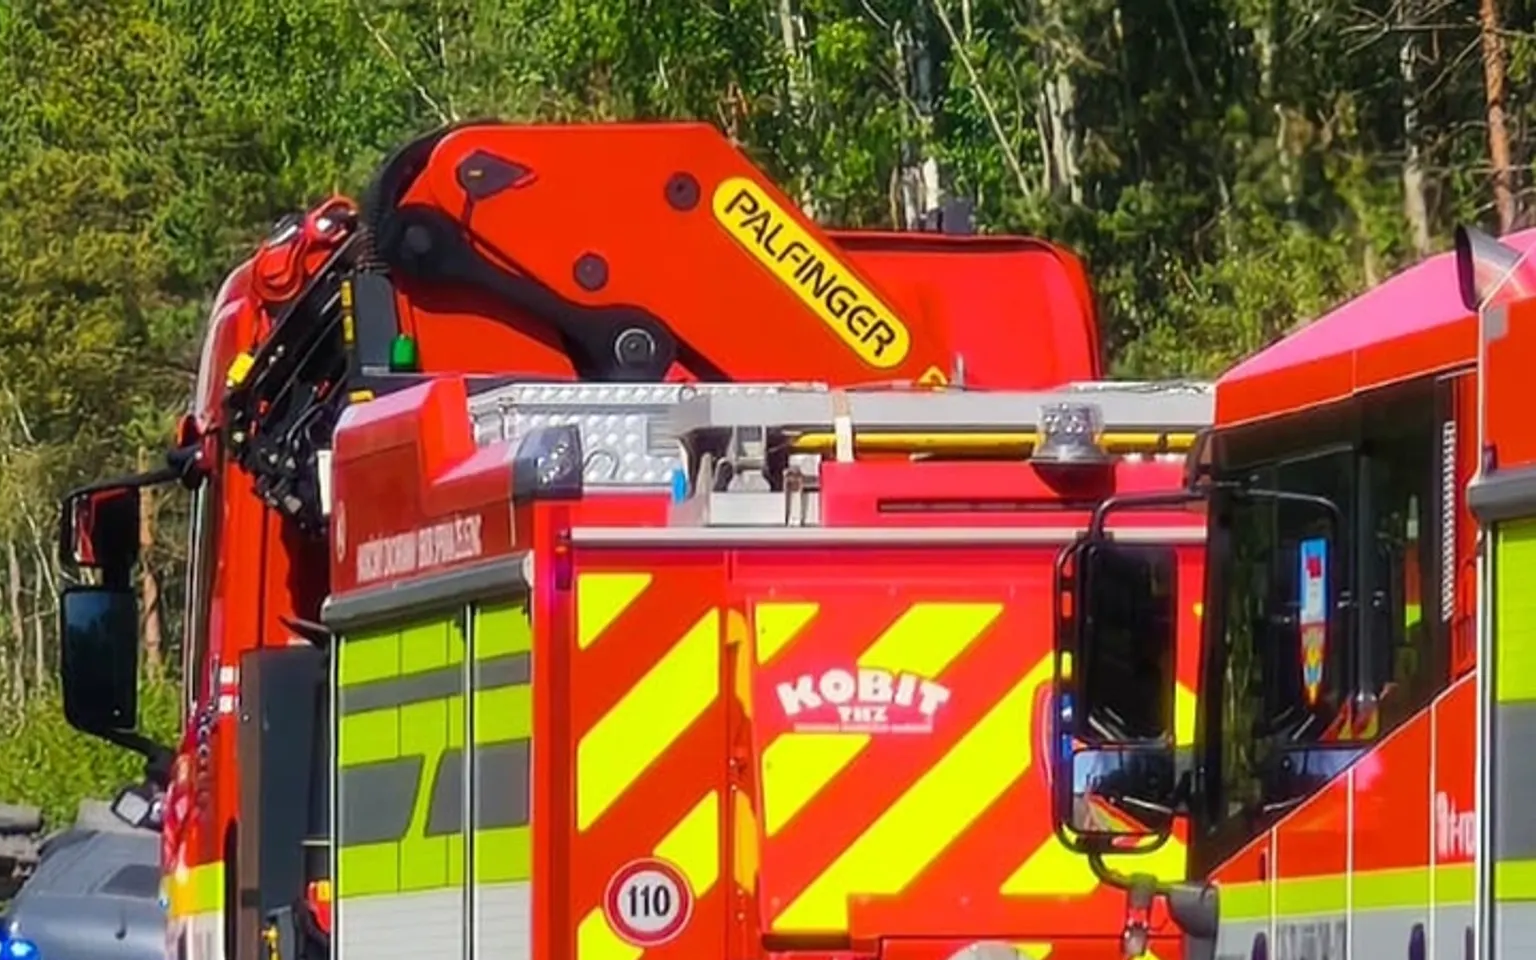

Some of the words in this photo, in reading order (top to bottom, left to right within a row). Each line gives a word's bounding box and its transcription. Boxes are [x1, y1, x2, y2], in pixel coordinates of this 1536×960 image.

[724, 188, 896, 357] PALFINGER
[776, 668, 951, 716] KOBIT
[627, 884, 671, 917] 110
